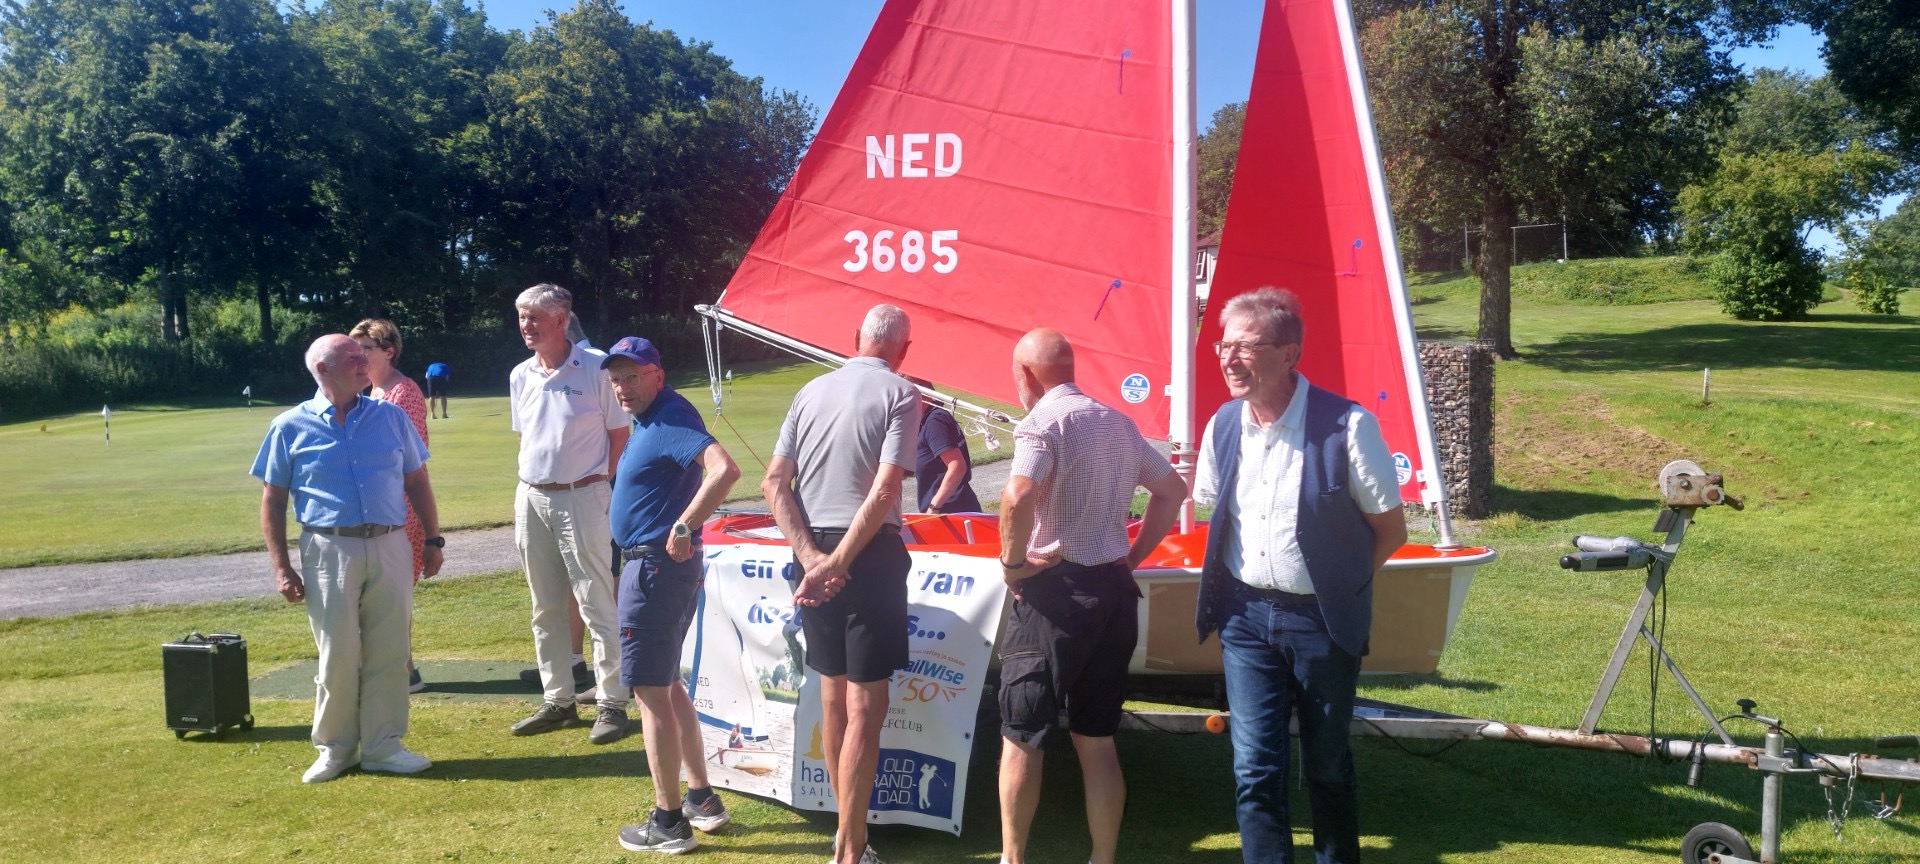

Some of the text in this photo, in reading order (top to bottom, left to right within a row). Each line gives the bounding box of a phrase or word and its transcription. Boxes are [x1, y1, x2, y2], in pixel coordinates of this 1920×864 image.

[866, 133, 962, 179] NED
[843, 229, 959, 274] 3685
[1130, 377, 1143, 387] N
[918, 570, 975, 596] van
[903, 660, 964, 685] ailWise
[902, 677, 940, 702] 50
[694, 698, 714, 709] 2579
[888, 707, 906, 715] IESE
[883, 719, 923, 732] FCLUB
[883, 758, 915, 774] OLD
[874, 773, 917, 789] RAND-
[800, 786, 833, 798] SAIL
[877, 790, 911, 804] DAD
